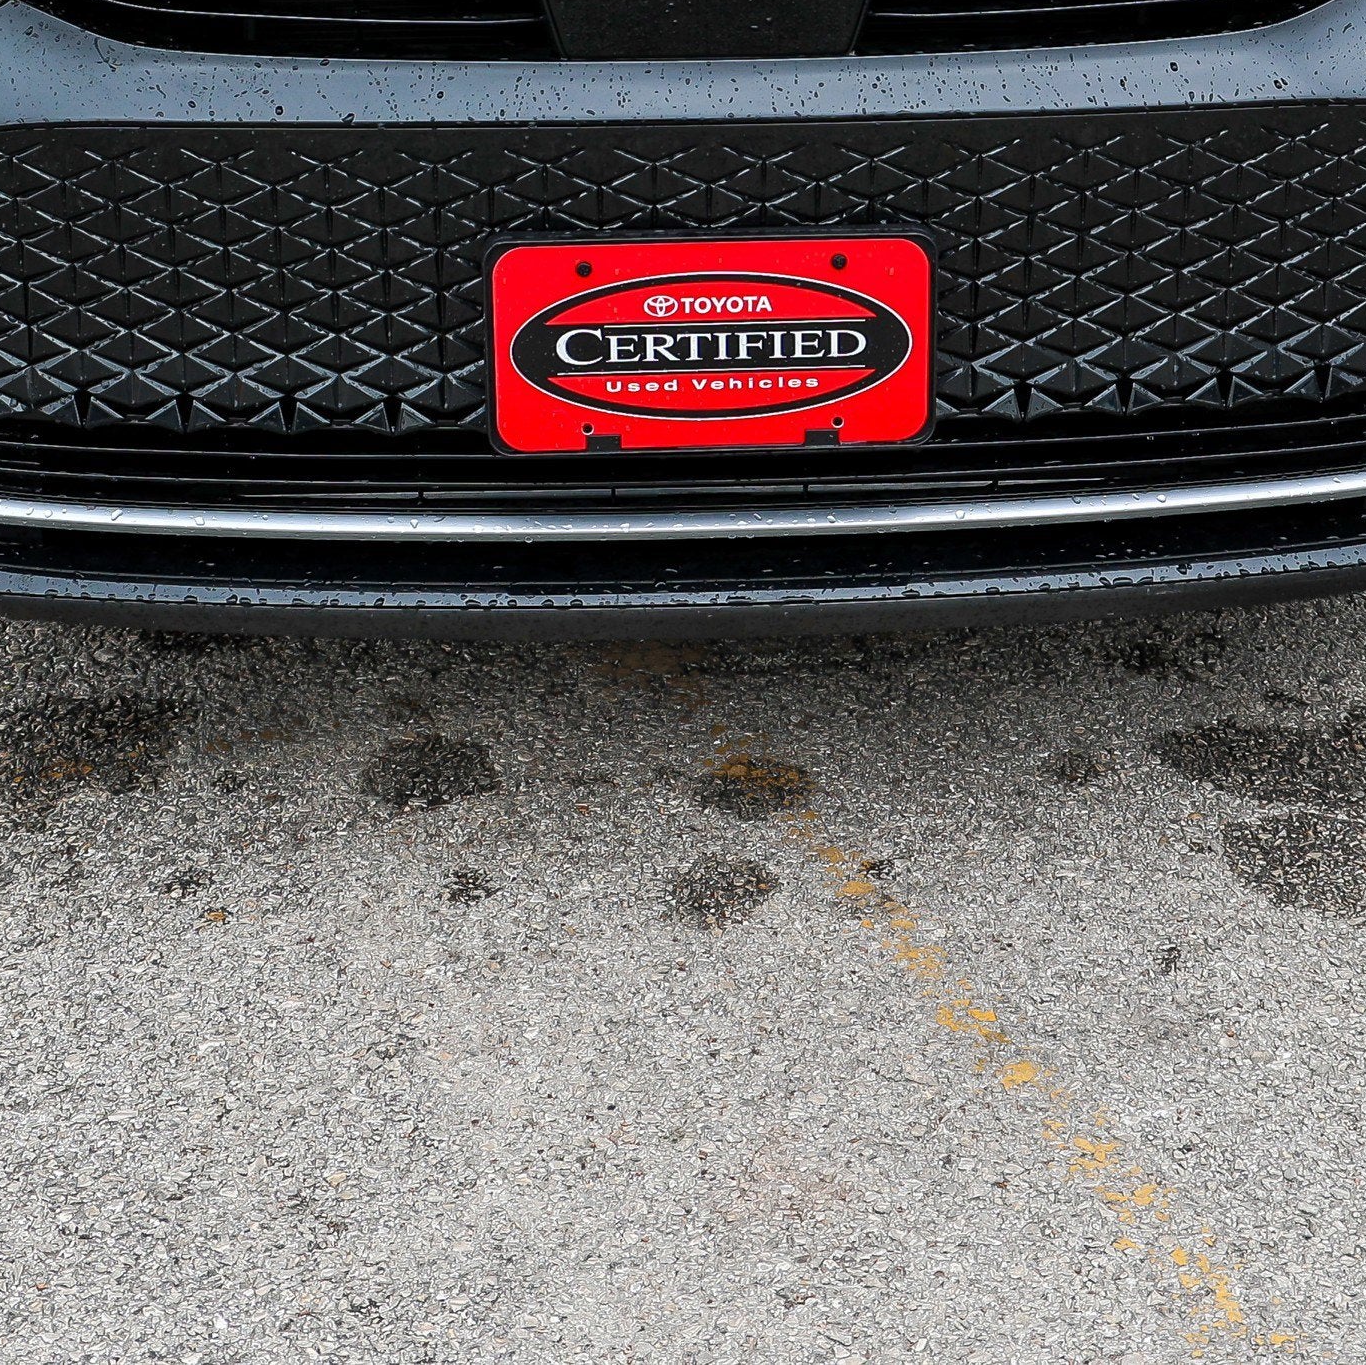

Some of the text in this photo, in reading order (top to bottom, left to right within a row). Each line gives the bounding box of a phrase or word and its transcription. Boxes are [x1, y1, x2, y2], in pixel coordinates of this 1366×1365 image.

[680, 296, 773, 314] TOYOTA
[606, 377, 819, 393] Used Vehicles
